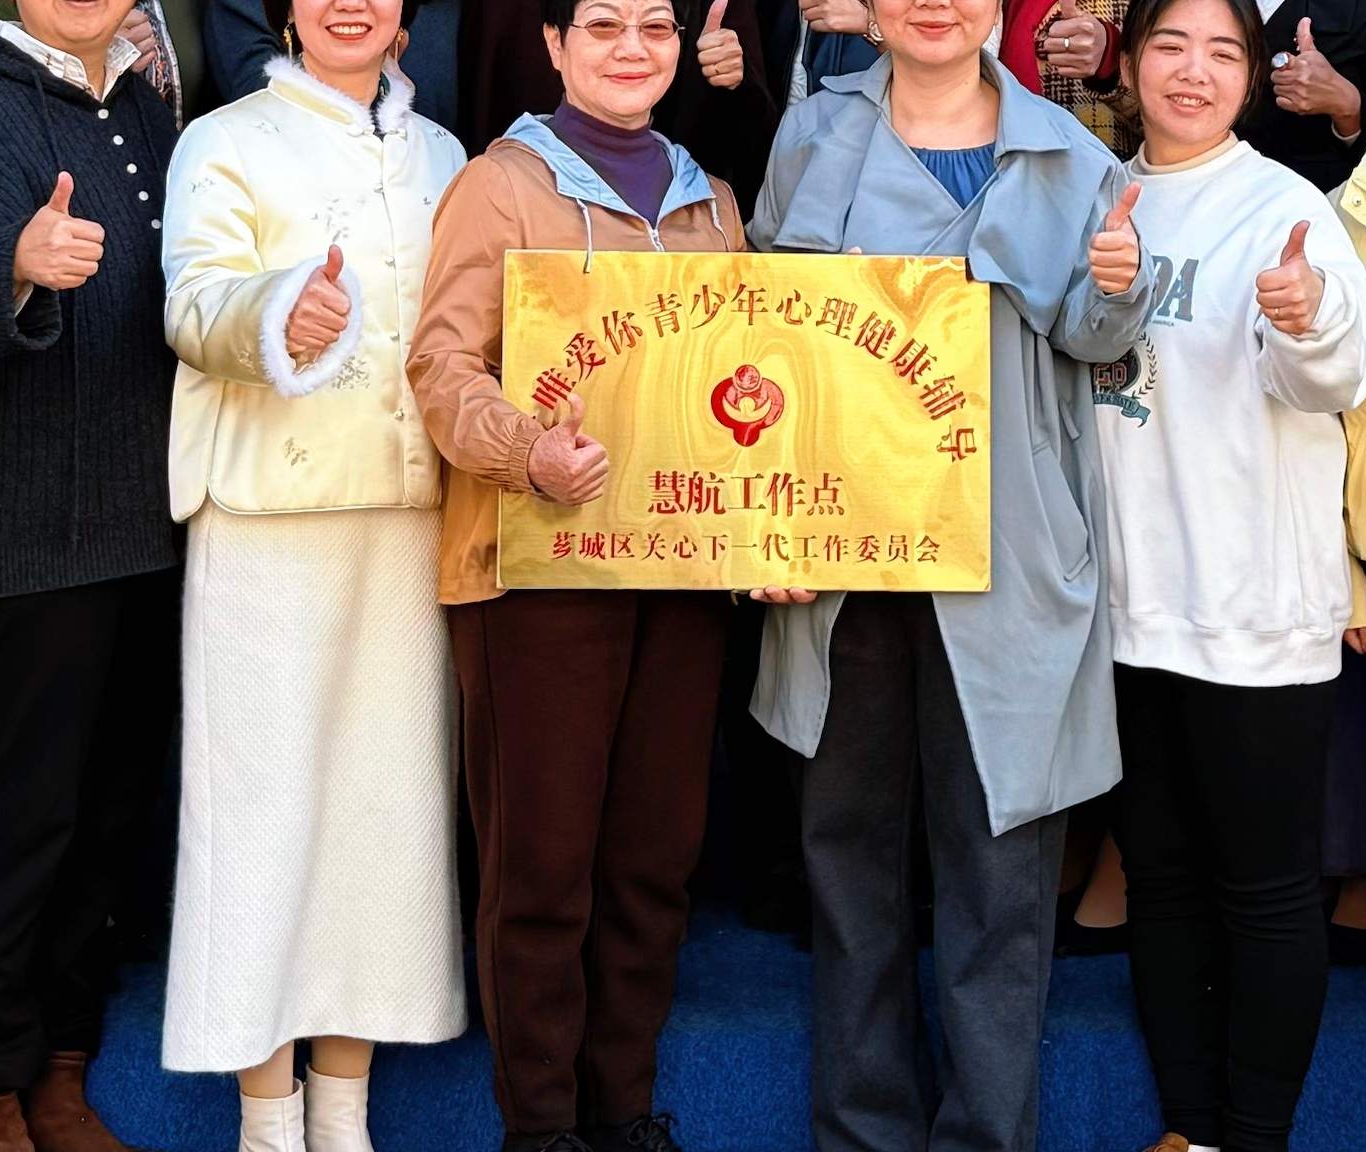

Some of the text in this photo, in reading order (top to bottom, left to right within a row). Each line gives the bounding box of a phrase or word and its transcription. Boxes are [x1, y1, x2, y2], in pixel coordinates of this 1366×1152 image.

[531, 282, 979, 466] 唯爱你青少年心理健康辅导
[647, 470, 846, 517] 慧航工作点
[552, 531, 941, 564] 芗城区关心下一代工作委员会
